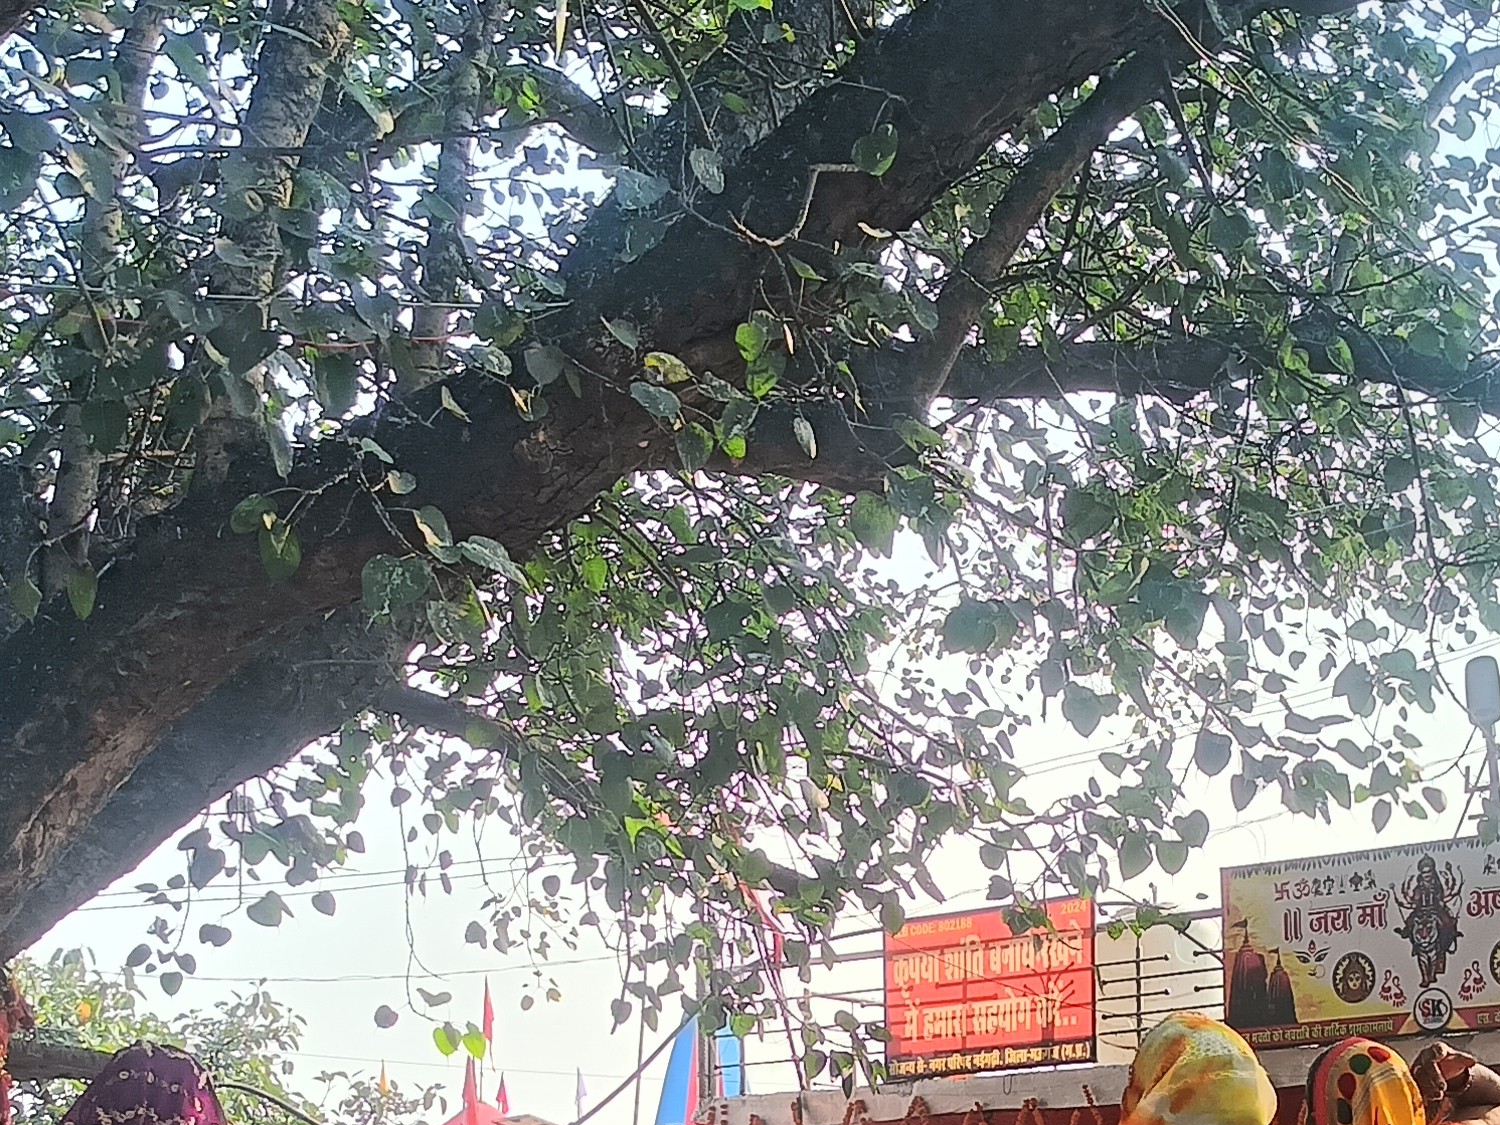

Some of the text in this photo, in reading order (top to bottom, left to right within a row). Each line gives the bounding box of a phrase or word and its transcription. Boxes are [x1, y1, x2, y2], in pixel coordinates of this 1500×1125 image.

[1060, 900, 1088, 915] 2024
[1308, 904, 1354, 935] जय
[1356, 888, 1391, 930] माँ
